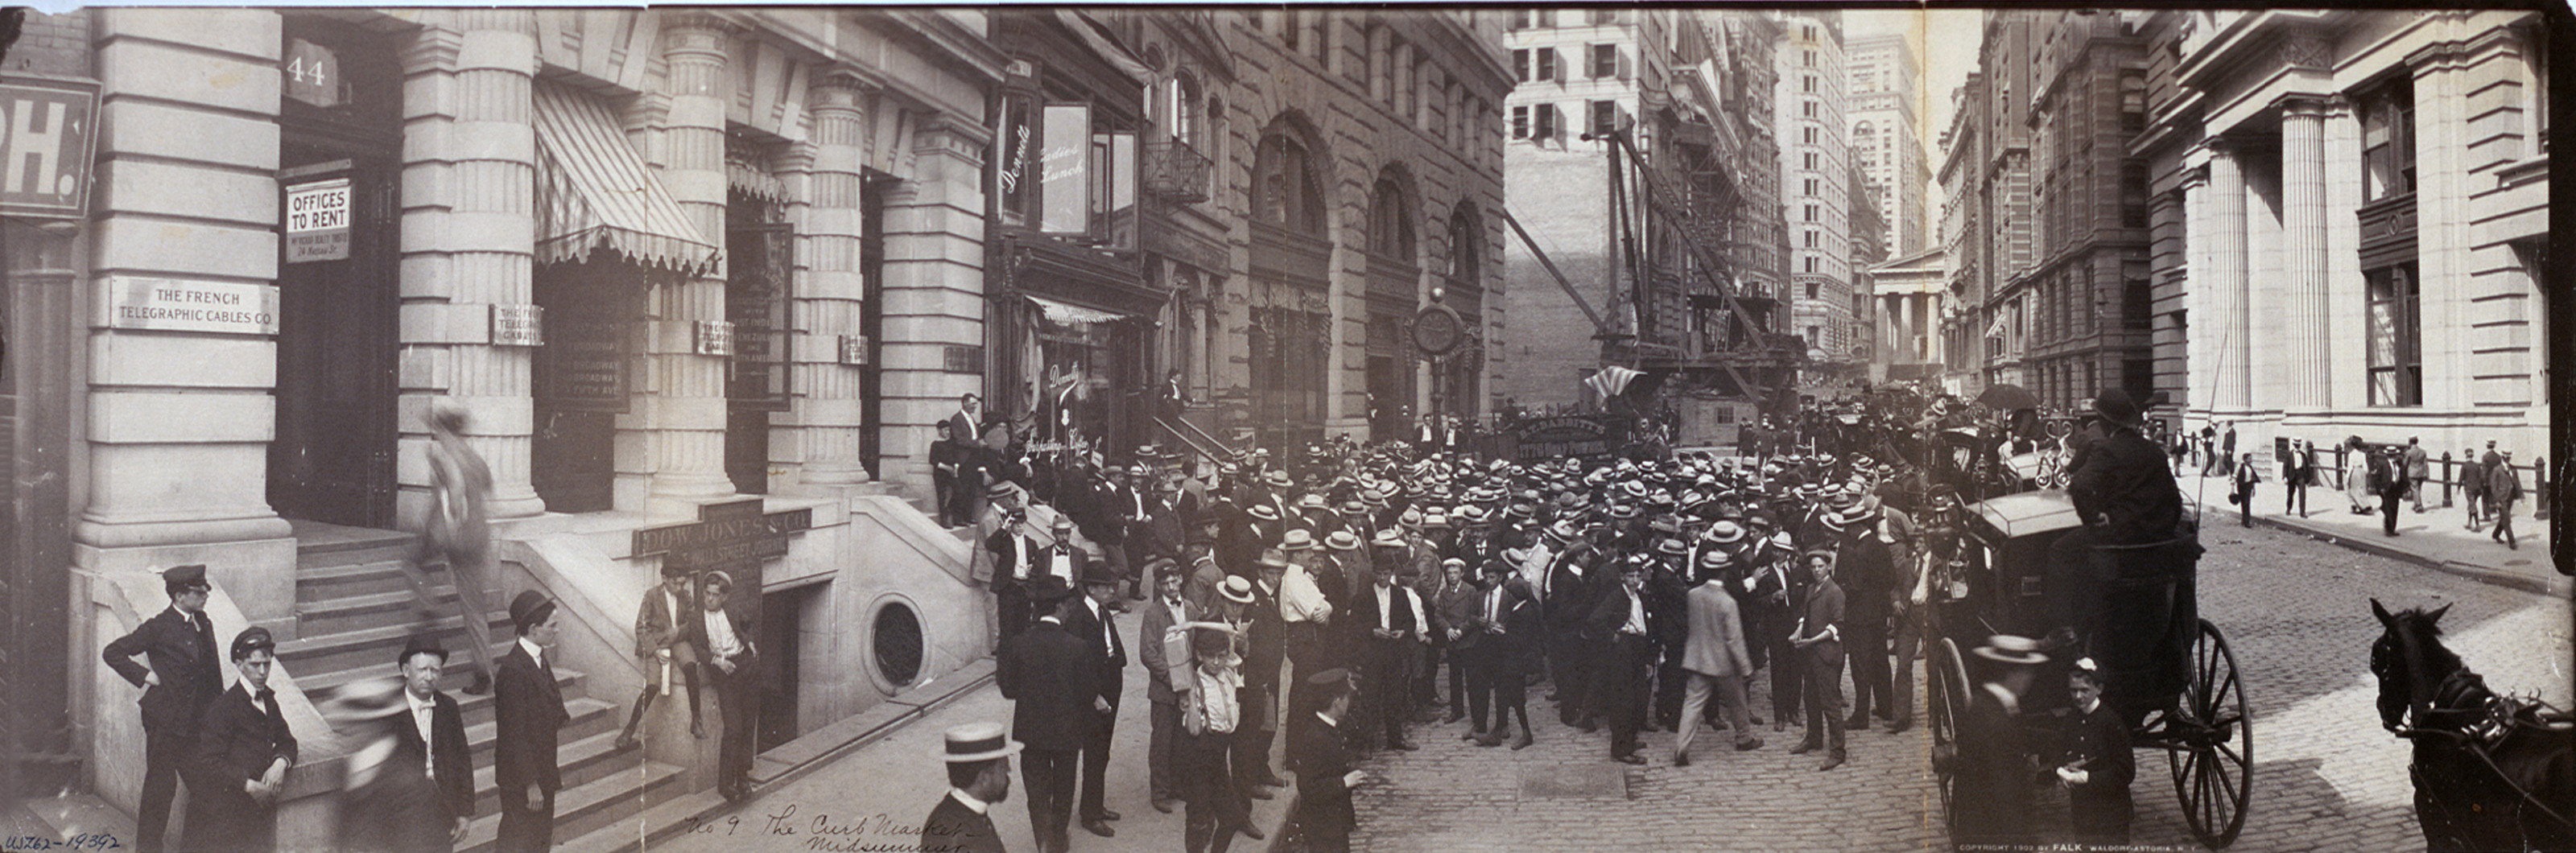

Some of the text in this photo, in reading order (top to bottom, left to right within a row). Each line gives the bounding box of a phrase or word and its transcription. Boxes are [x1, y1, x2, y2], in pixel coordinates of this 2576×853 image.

[287, 56, 325, 86] 44
[0, 99, 75, 196] H.
[1040, 158, 1084, 183] Lunch
[293, 192, 345, 212] OFFICES
[292, 209, 346, 229] TO RENT
[156, 289, 241, 305] THE FRENCH
[119, 305, 272, 325] TELEGRAPHIC CABLES CO.
[699, 517, 763, 543] JONES
[691, 549, 714, 567] WALL
[716, 542, 750, 562] STREET
